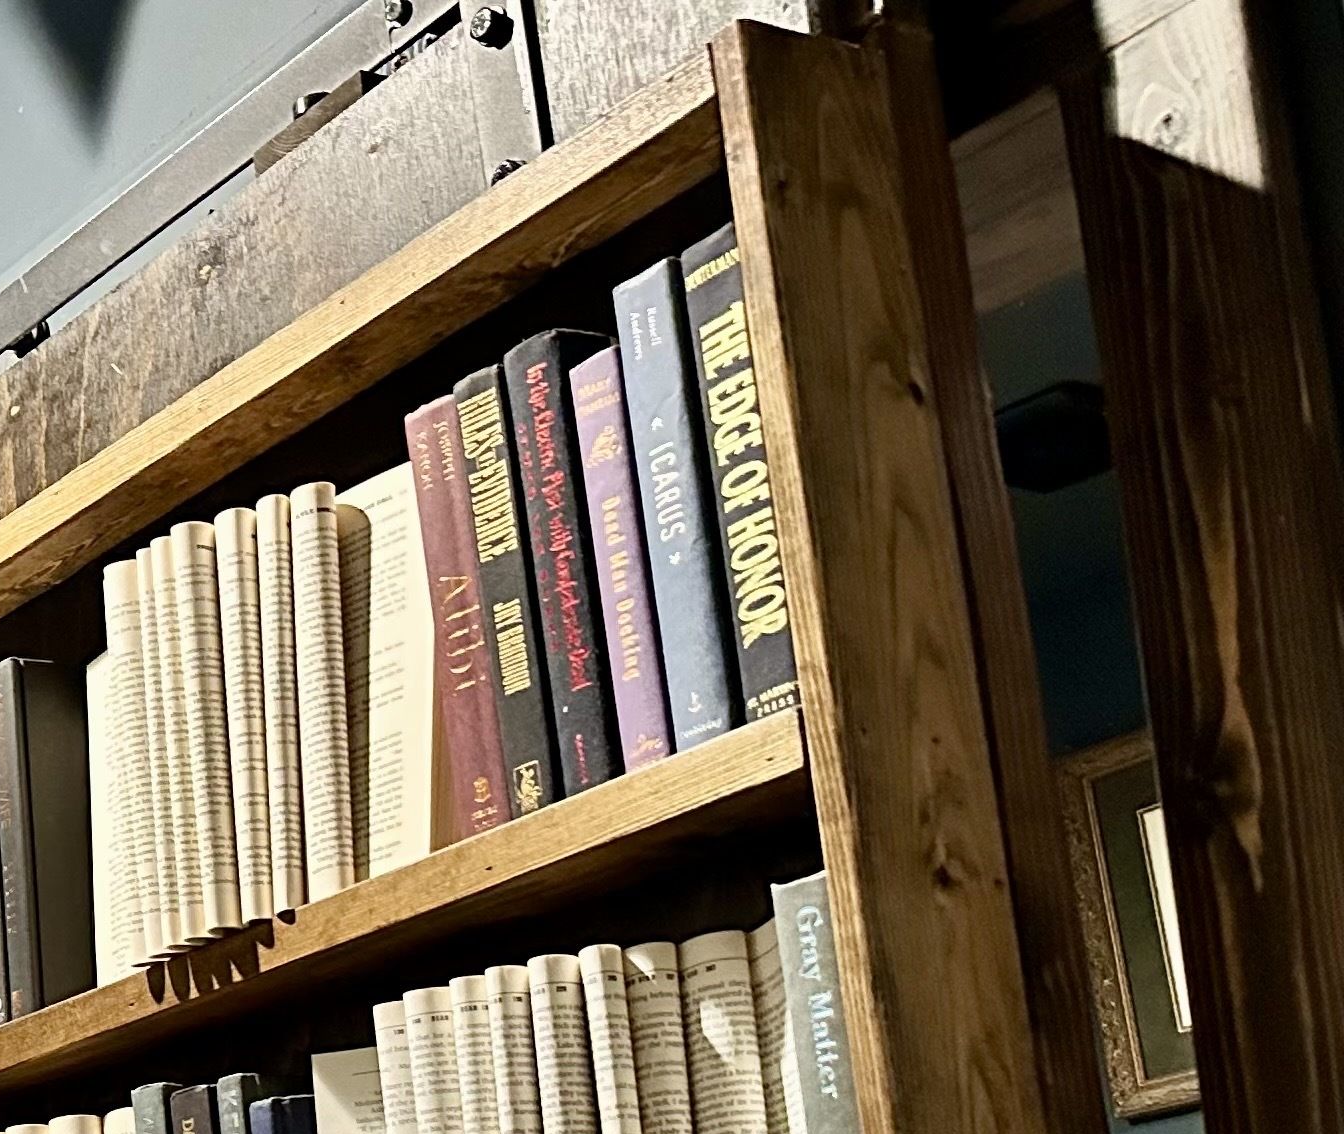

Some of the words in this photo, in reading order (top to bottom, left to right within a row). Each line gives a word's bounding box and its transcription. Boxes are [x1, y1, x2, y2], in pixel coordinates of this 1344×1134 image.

[628, 311, 644, 362] Andrews
[699, 300, 750, 381] THE
[456, 386, 505, 461] RULES
[707, 367, 763, 467] EDGE
[467, 457, 519, 566] EVIDENCE
[648, 441, 687, 543] ICARUS
[720, 459, 772, 515] OF
[727, 508, 789, 650] HONOR
[438, 574, 487, 698] Alibi
[615, 597, 642, 682] Docking
[794, 903, 821, 983] Gray
[808, 989, 839, 1101] Matter
